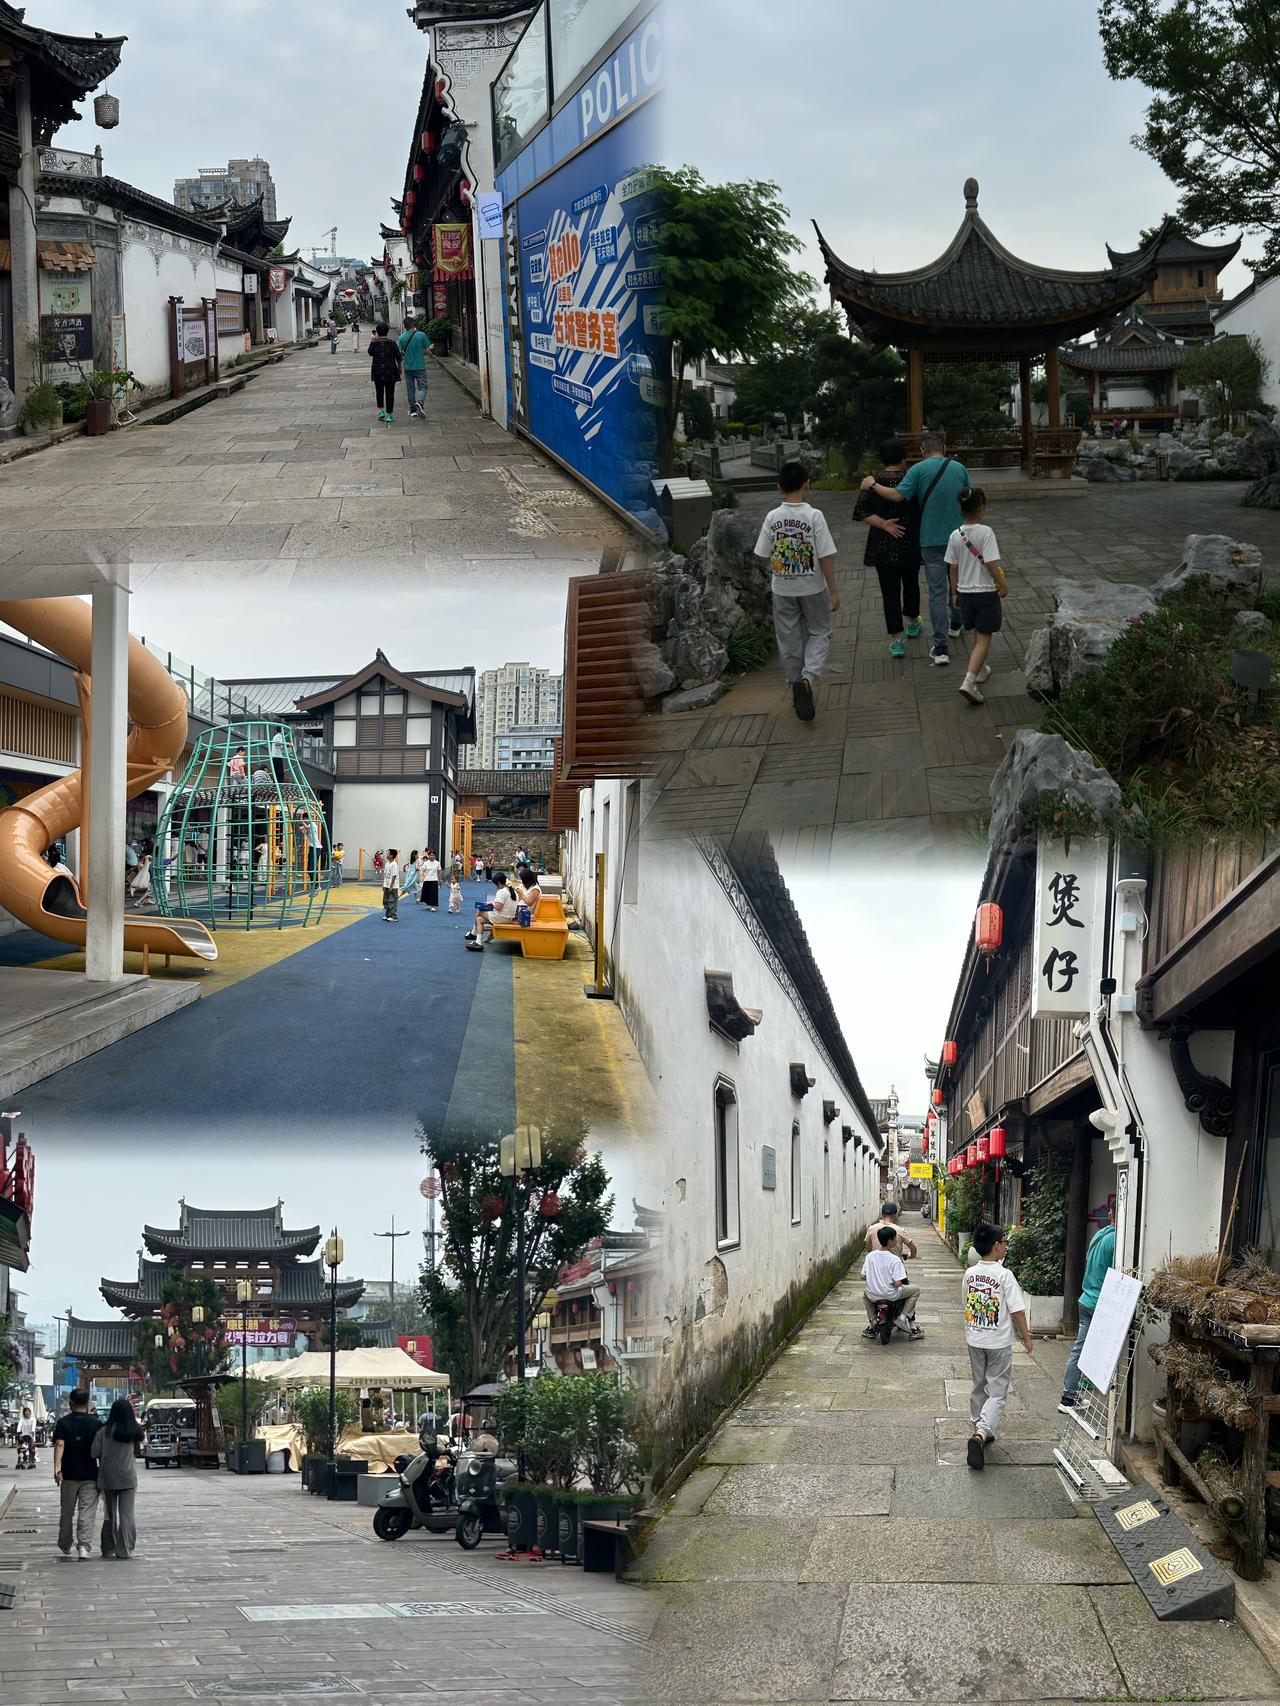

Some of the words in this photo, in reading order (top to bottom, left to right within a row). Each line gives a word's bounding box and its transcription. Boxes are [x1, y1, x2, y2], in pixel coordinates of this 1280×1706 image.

[549, 232, 580, 282] Hello
[557, 286, 572, 302] 这里是
[554, 310, 618, 354] 古城警务室
[784, 518, 812, 534] RIBBON
[1042, 871, 1085, 993] 煲仔
[976, 1274, 1003, 1290] RIBBON
